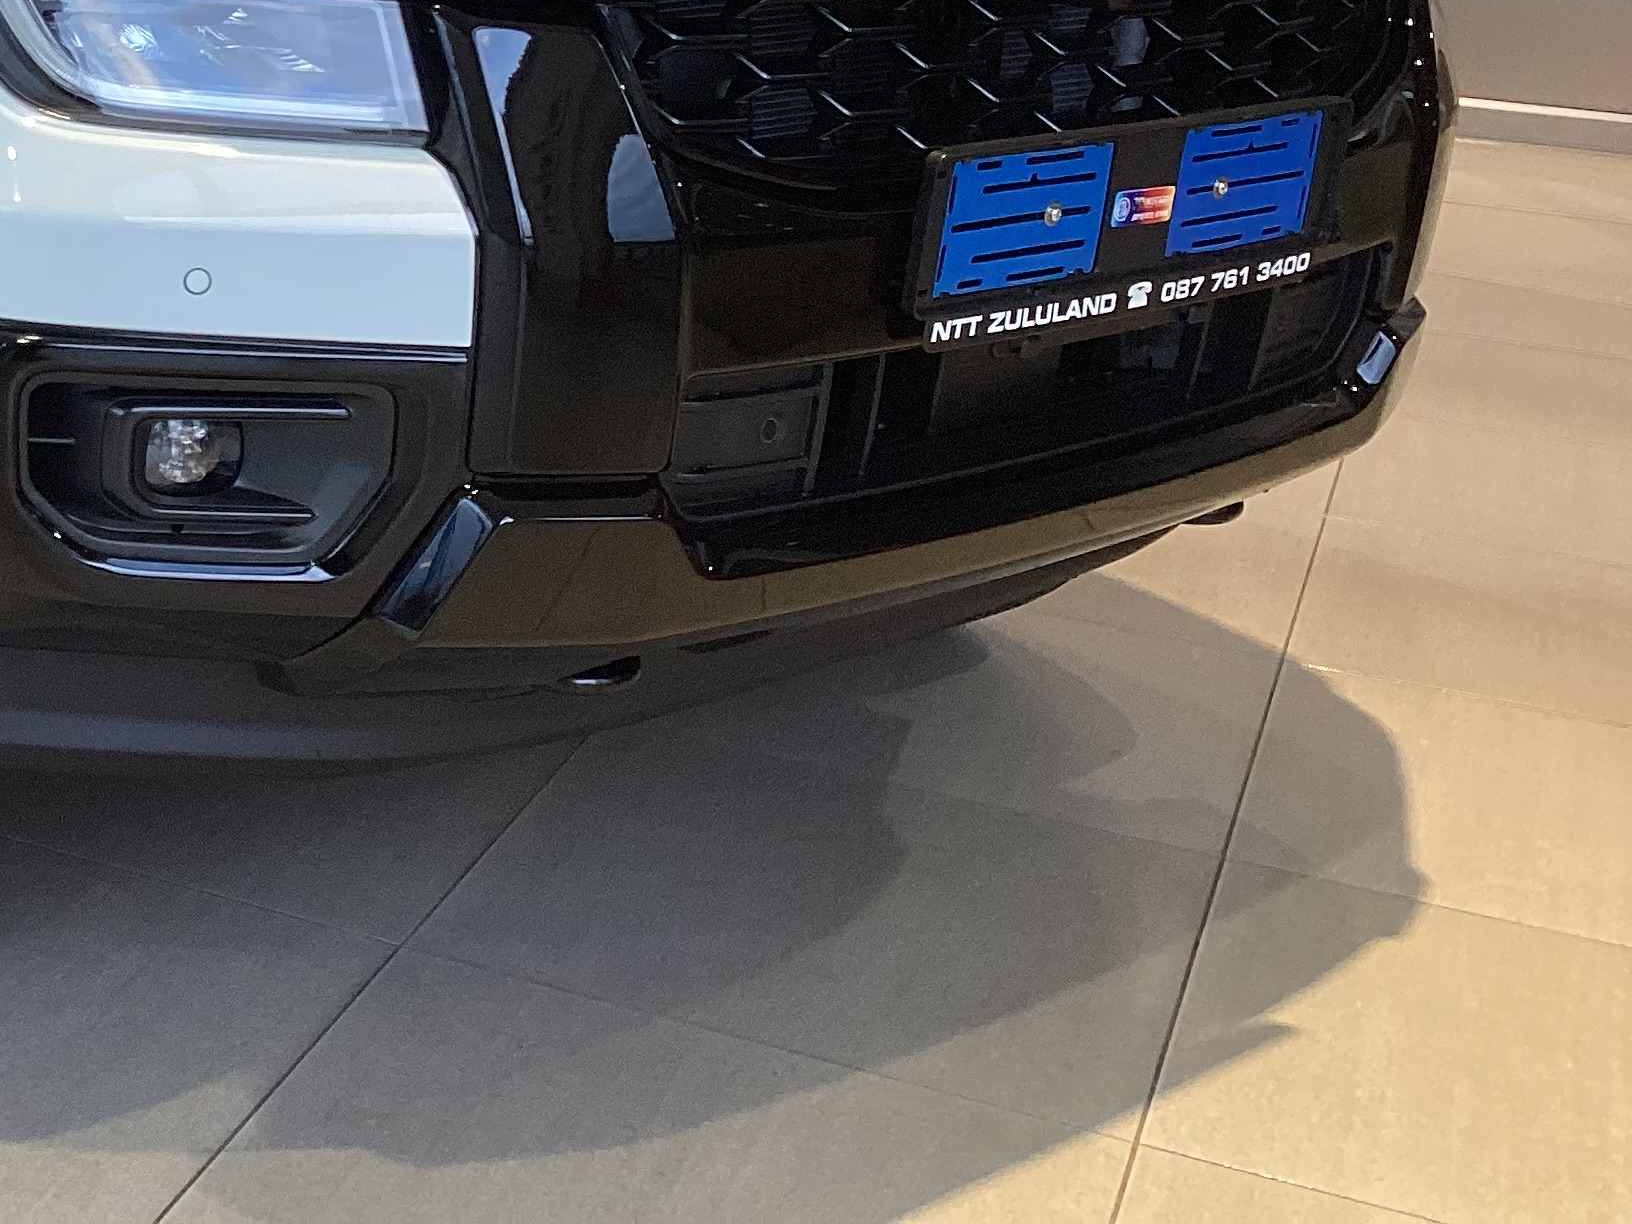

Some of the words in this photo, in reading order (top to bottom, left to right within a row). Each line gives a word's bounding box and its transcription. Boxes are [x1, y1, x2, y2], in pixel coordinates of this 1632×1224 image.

[929, 315, 985, 343] NTT
[987, 292, 1118, 335] ZULULAND
[1160, 284, 1204, 304] 087
[1211, 267, 1249, 291] 761
[1256, 252, 1311, 282] 3400
